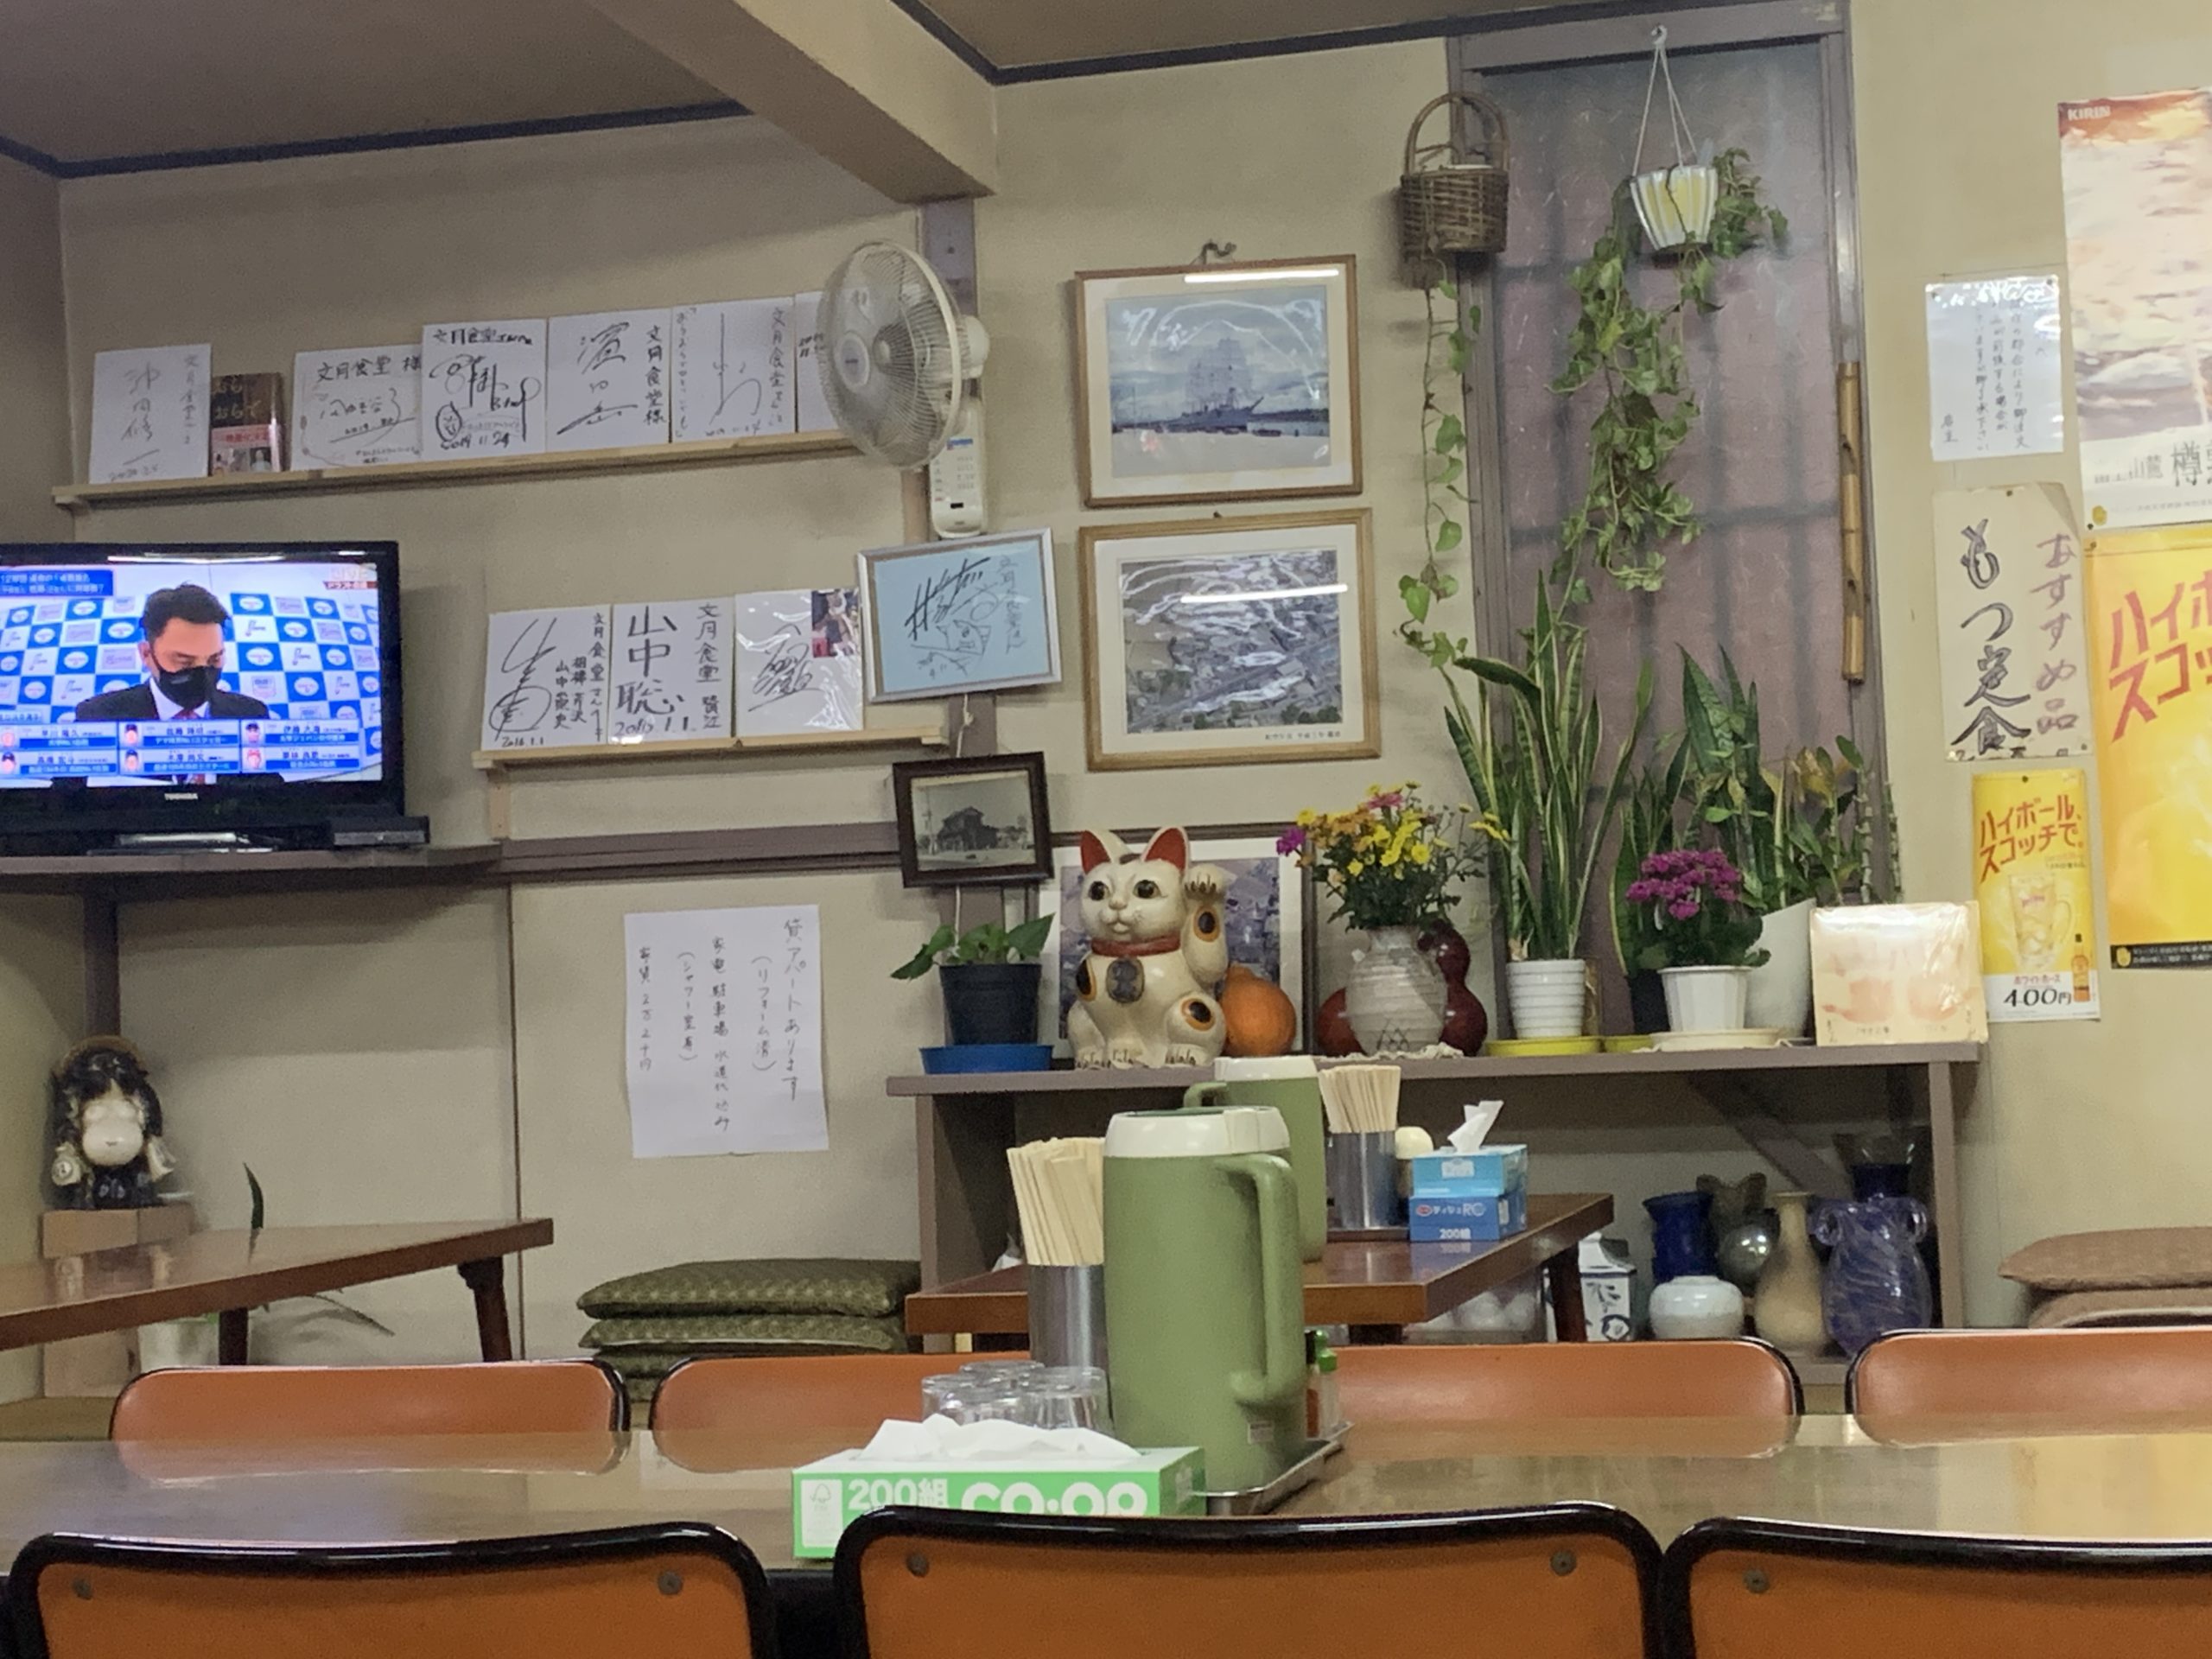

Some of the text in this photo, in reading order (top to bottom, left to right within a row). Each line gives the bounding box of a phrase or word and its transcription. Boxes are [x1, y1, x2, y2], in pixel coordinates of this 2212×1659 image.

[2068, 105, 2111, 121] KIRIN
[695, 603, 721, 683] 文月食堂
[1950, 518, 2032, 756] もつ定食
[2031, 533, 2079, 735] おすすめ品
[848, 1477, 949, 1511] 200組
